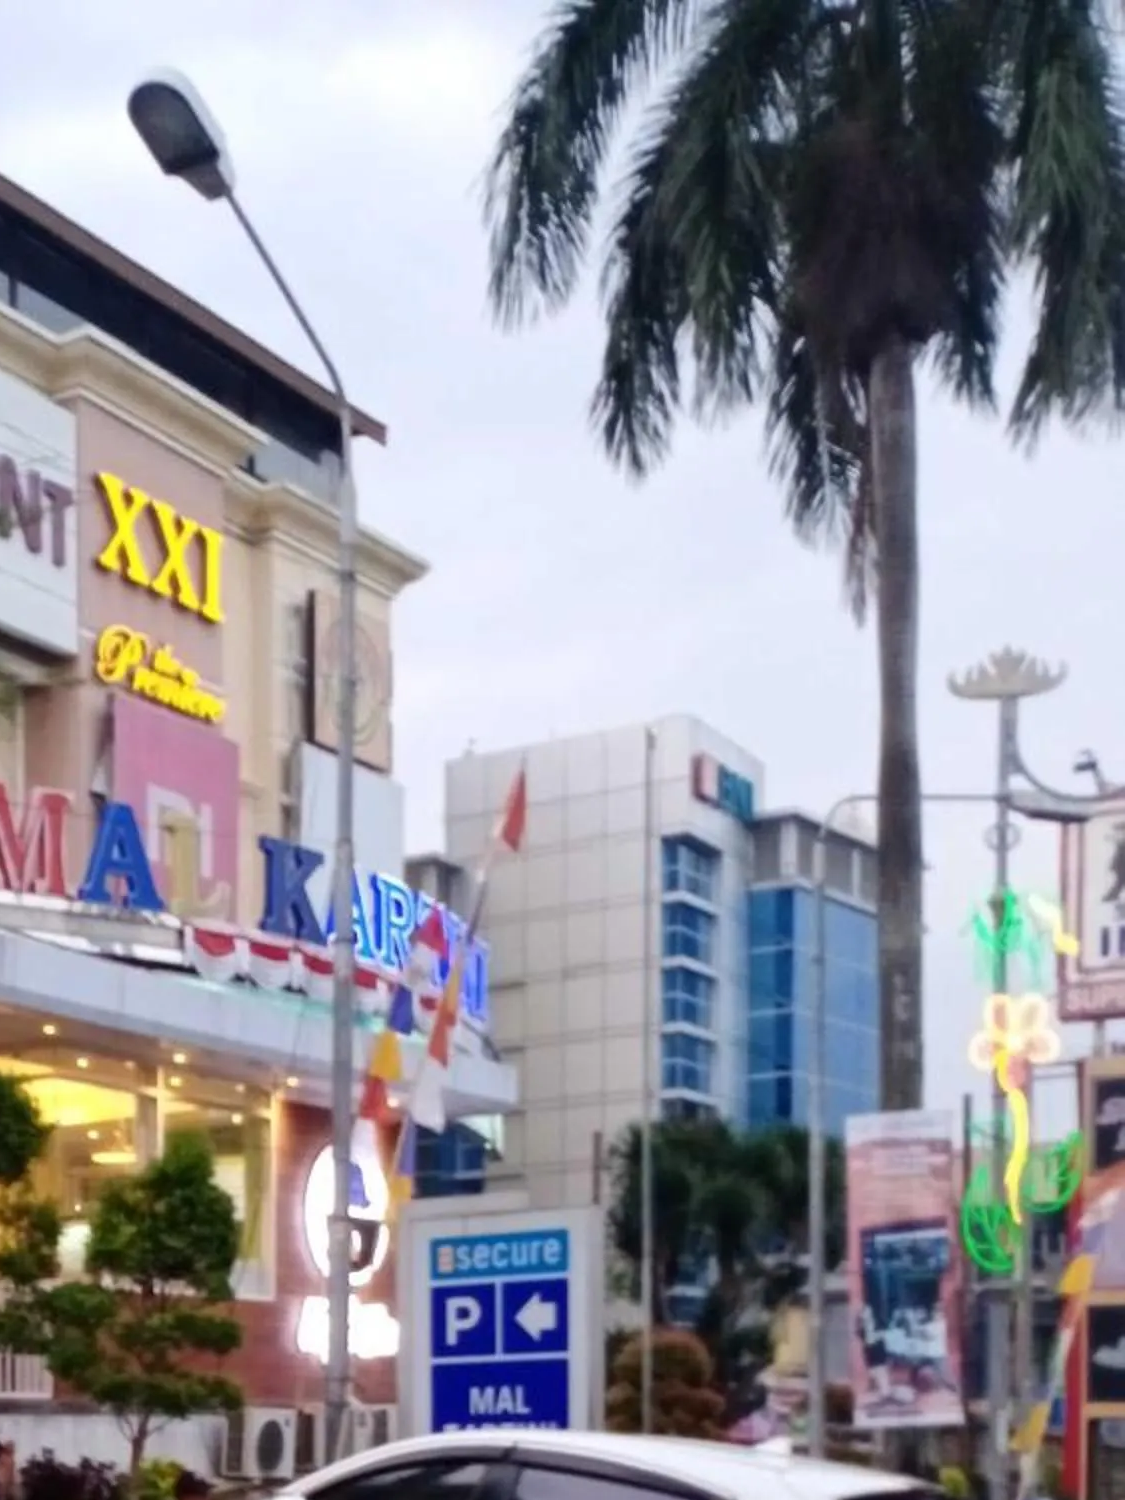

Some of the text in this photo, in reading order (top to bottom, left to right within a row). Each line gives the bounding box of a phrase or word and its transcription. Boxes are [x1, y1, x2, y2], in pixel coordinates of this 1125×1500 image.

[96, 471, 226, 624] XXI
[444, 1296, 482, 1346] P
[468, 1385, 532, 1416] MAL
